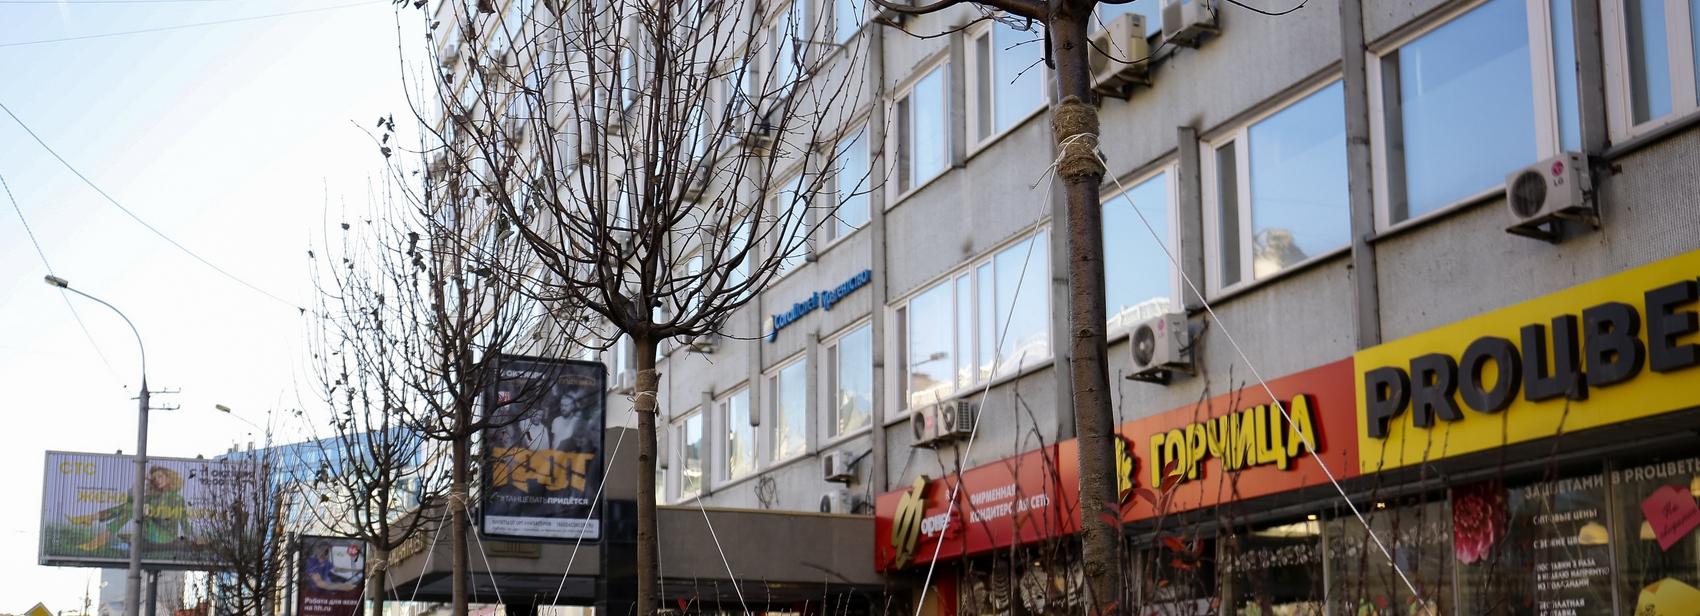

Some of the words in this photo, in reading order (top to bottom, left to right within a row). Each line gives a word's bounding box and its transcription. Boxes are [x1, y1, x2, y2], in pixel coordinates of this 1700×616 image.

[1150, 394, 1316, 489] ГОРЧИЦА
[1611, 471, 1620, 485] В
[970, 483, 1016, 506] ФИРМЕННАЯ
[1030, 493, 1049, 510] СЕТЬ
